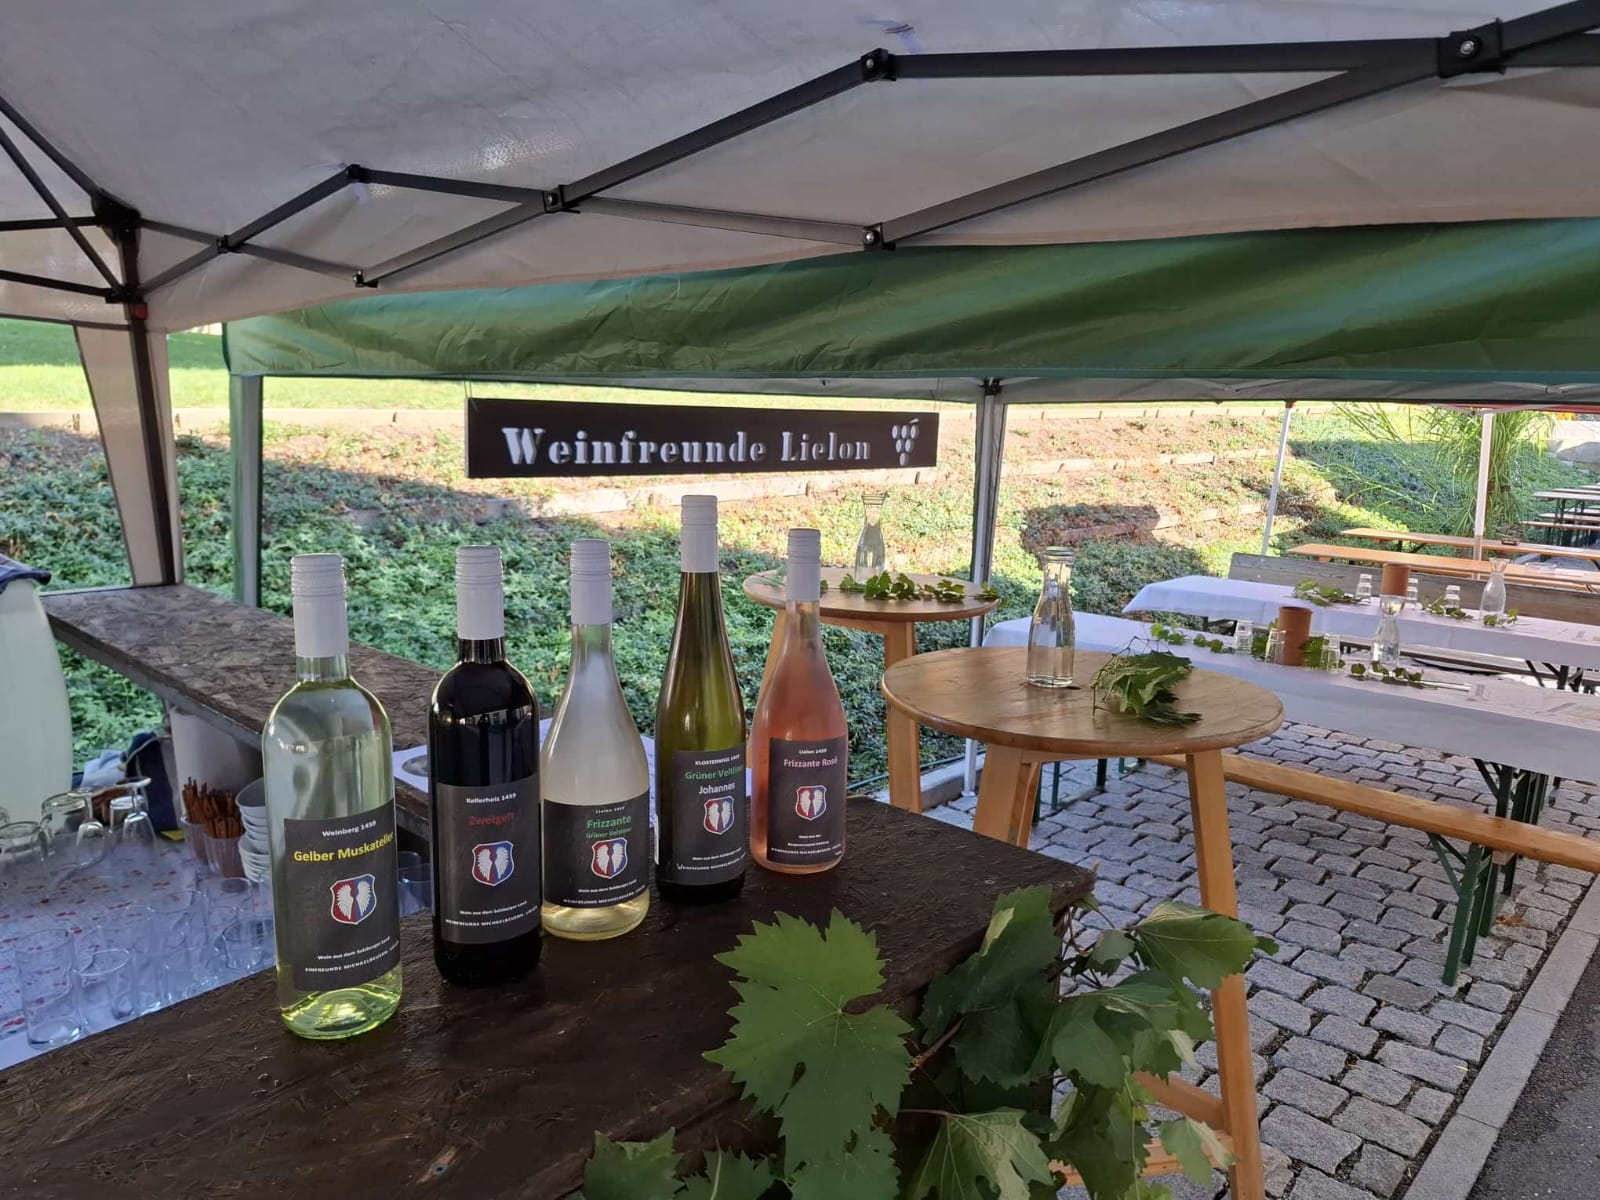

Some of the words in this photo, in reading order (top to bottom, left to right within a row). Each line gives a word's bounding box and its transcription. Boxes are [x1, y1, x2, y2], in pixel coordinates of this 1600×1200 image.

[501, 426, 766, 466] Weinfreunde
[780, 429, 871, 463] Lielon
[783, 758, 821, 768] Frizzante
[822, 756, 838, 767] Rosé
[685, 770, 716, 781] Grüner
[698, 782, 736, 795] Johannes
[469, 812, 515, 826] Zweigelt
[586, 815, 632, 829] Frizzante
[321, 825, 360, 838] Weinberg
[360, 819, 377, 831] 1459
[293, 850, 335, 862] Gelber
